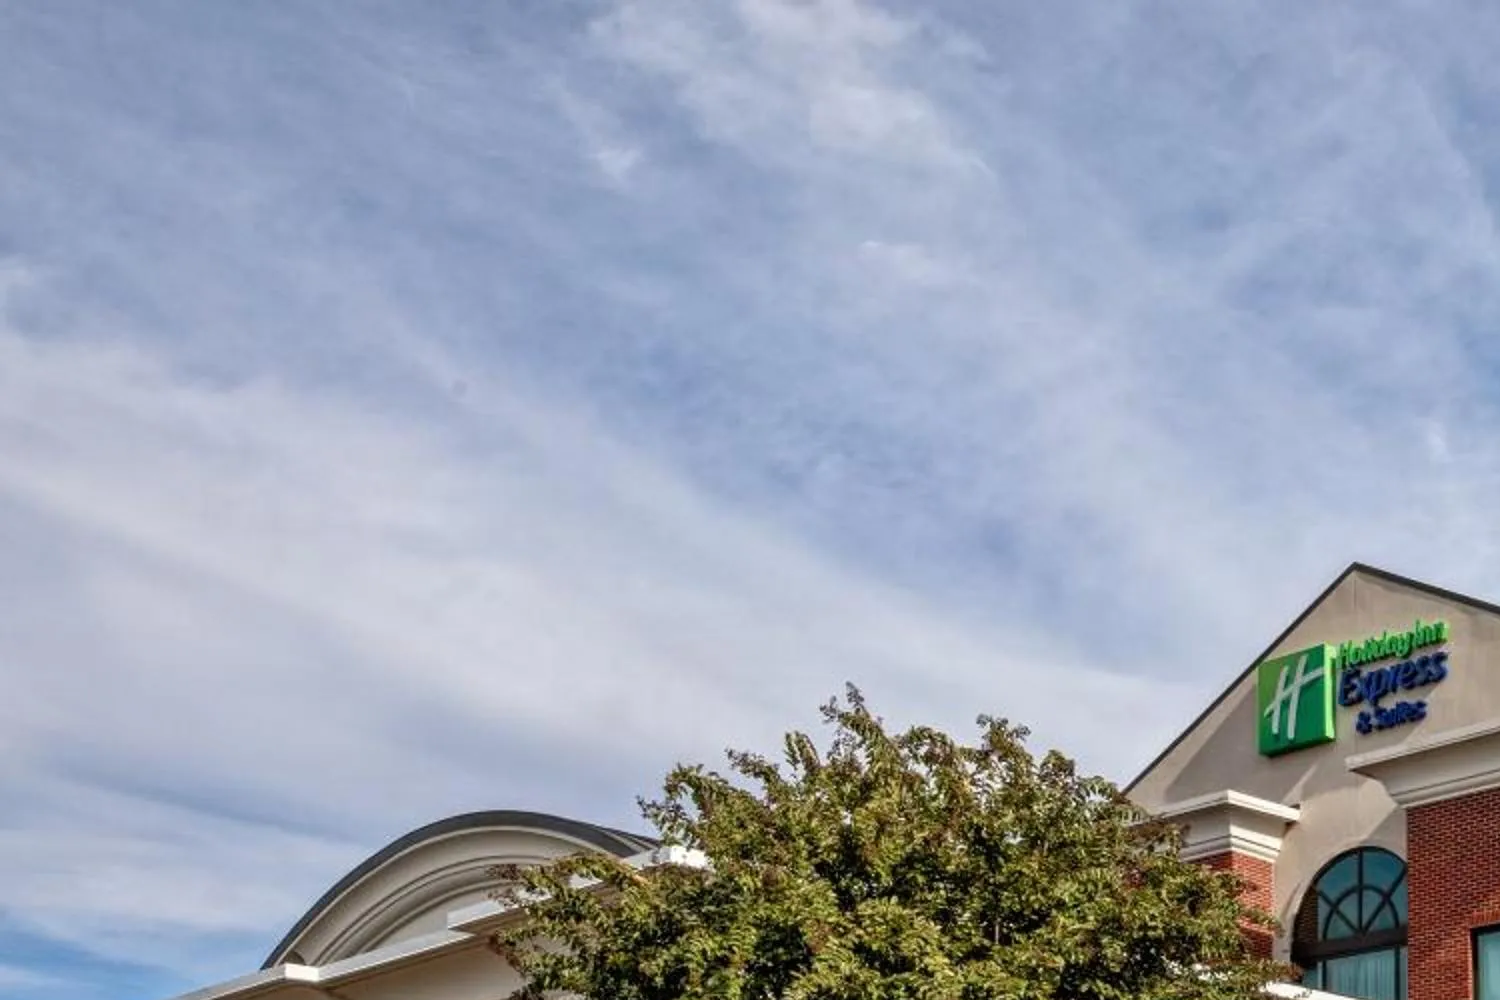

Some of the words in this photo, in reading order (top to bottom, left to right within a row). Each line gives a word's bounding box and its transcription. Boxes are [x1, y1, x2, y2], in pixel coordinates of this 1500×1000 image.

[1338, 651, 1449, 707] Express
[1356, 711, 1373, 735] &
[1374, 700, 1428, 730] Suites
